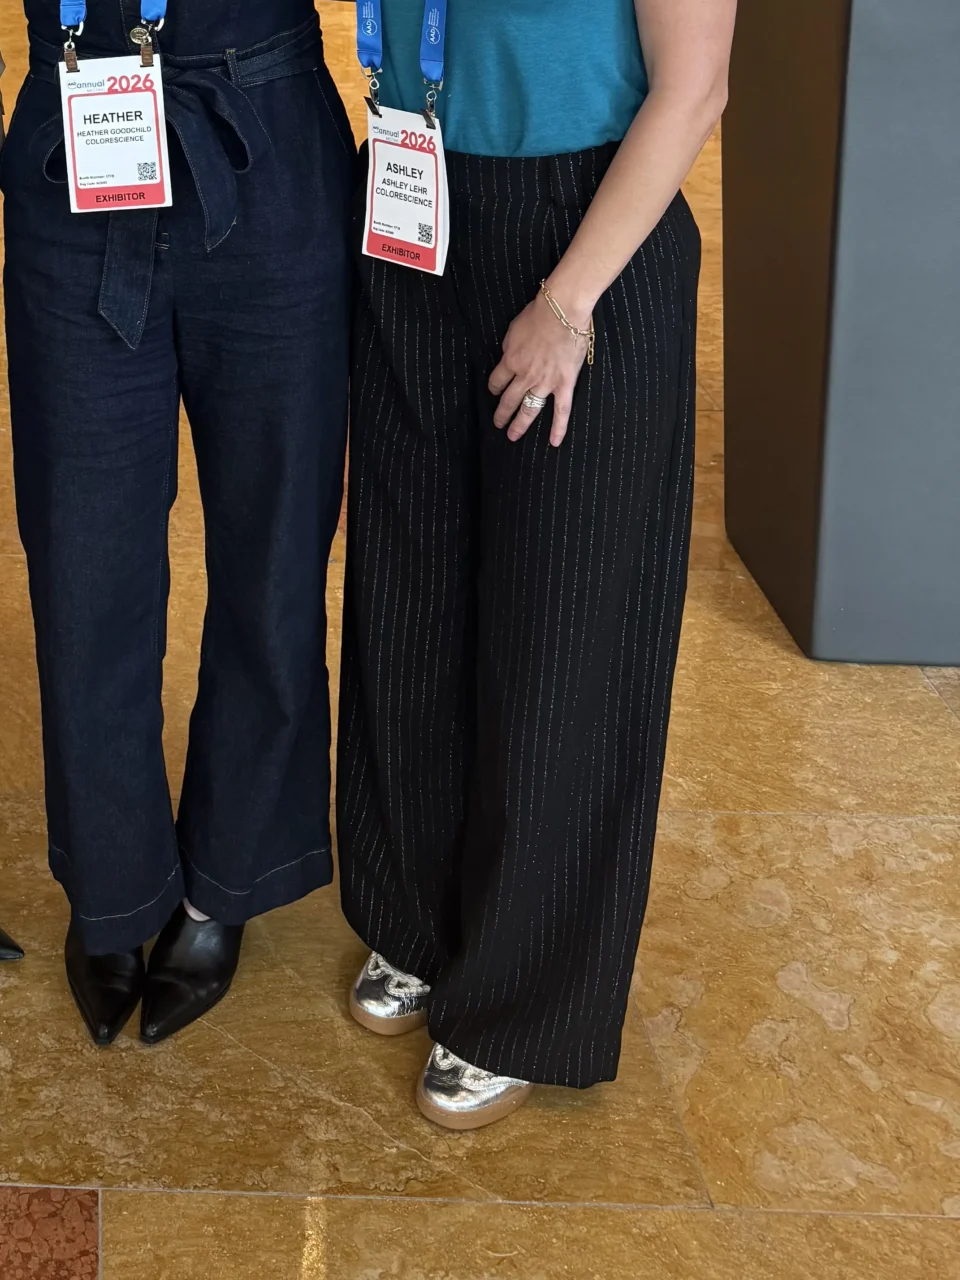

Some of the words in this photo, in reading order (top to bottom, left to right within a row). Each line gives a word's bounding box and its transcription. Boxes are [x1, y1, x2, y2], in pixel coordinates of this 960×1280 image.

[77, 79, 105, 89] annual
[107, 74, 155, 93] 2026
[83, 110, 144, 125] HEATHER
[76, 129, 109, 138] HEATHER
[110, 125, 152, 136] GOODCHILD
[85, 135, 145, 146] COLORESCIENCE
[400, 129, 436, 153] 2026
[386, 162, 424, 180] ASHLEY
[381, 177, 409, 191] ASHLEY
[409, 185, 428, 195] LEHR
[95, 192, 146, 203] EXHIBITOR
[375, 187, 433, 208] COLORESCIENCE
[381, 243, 421, 261] EXHIBITOR
